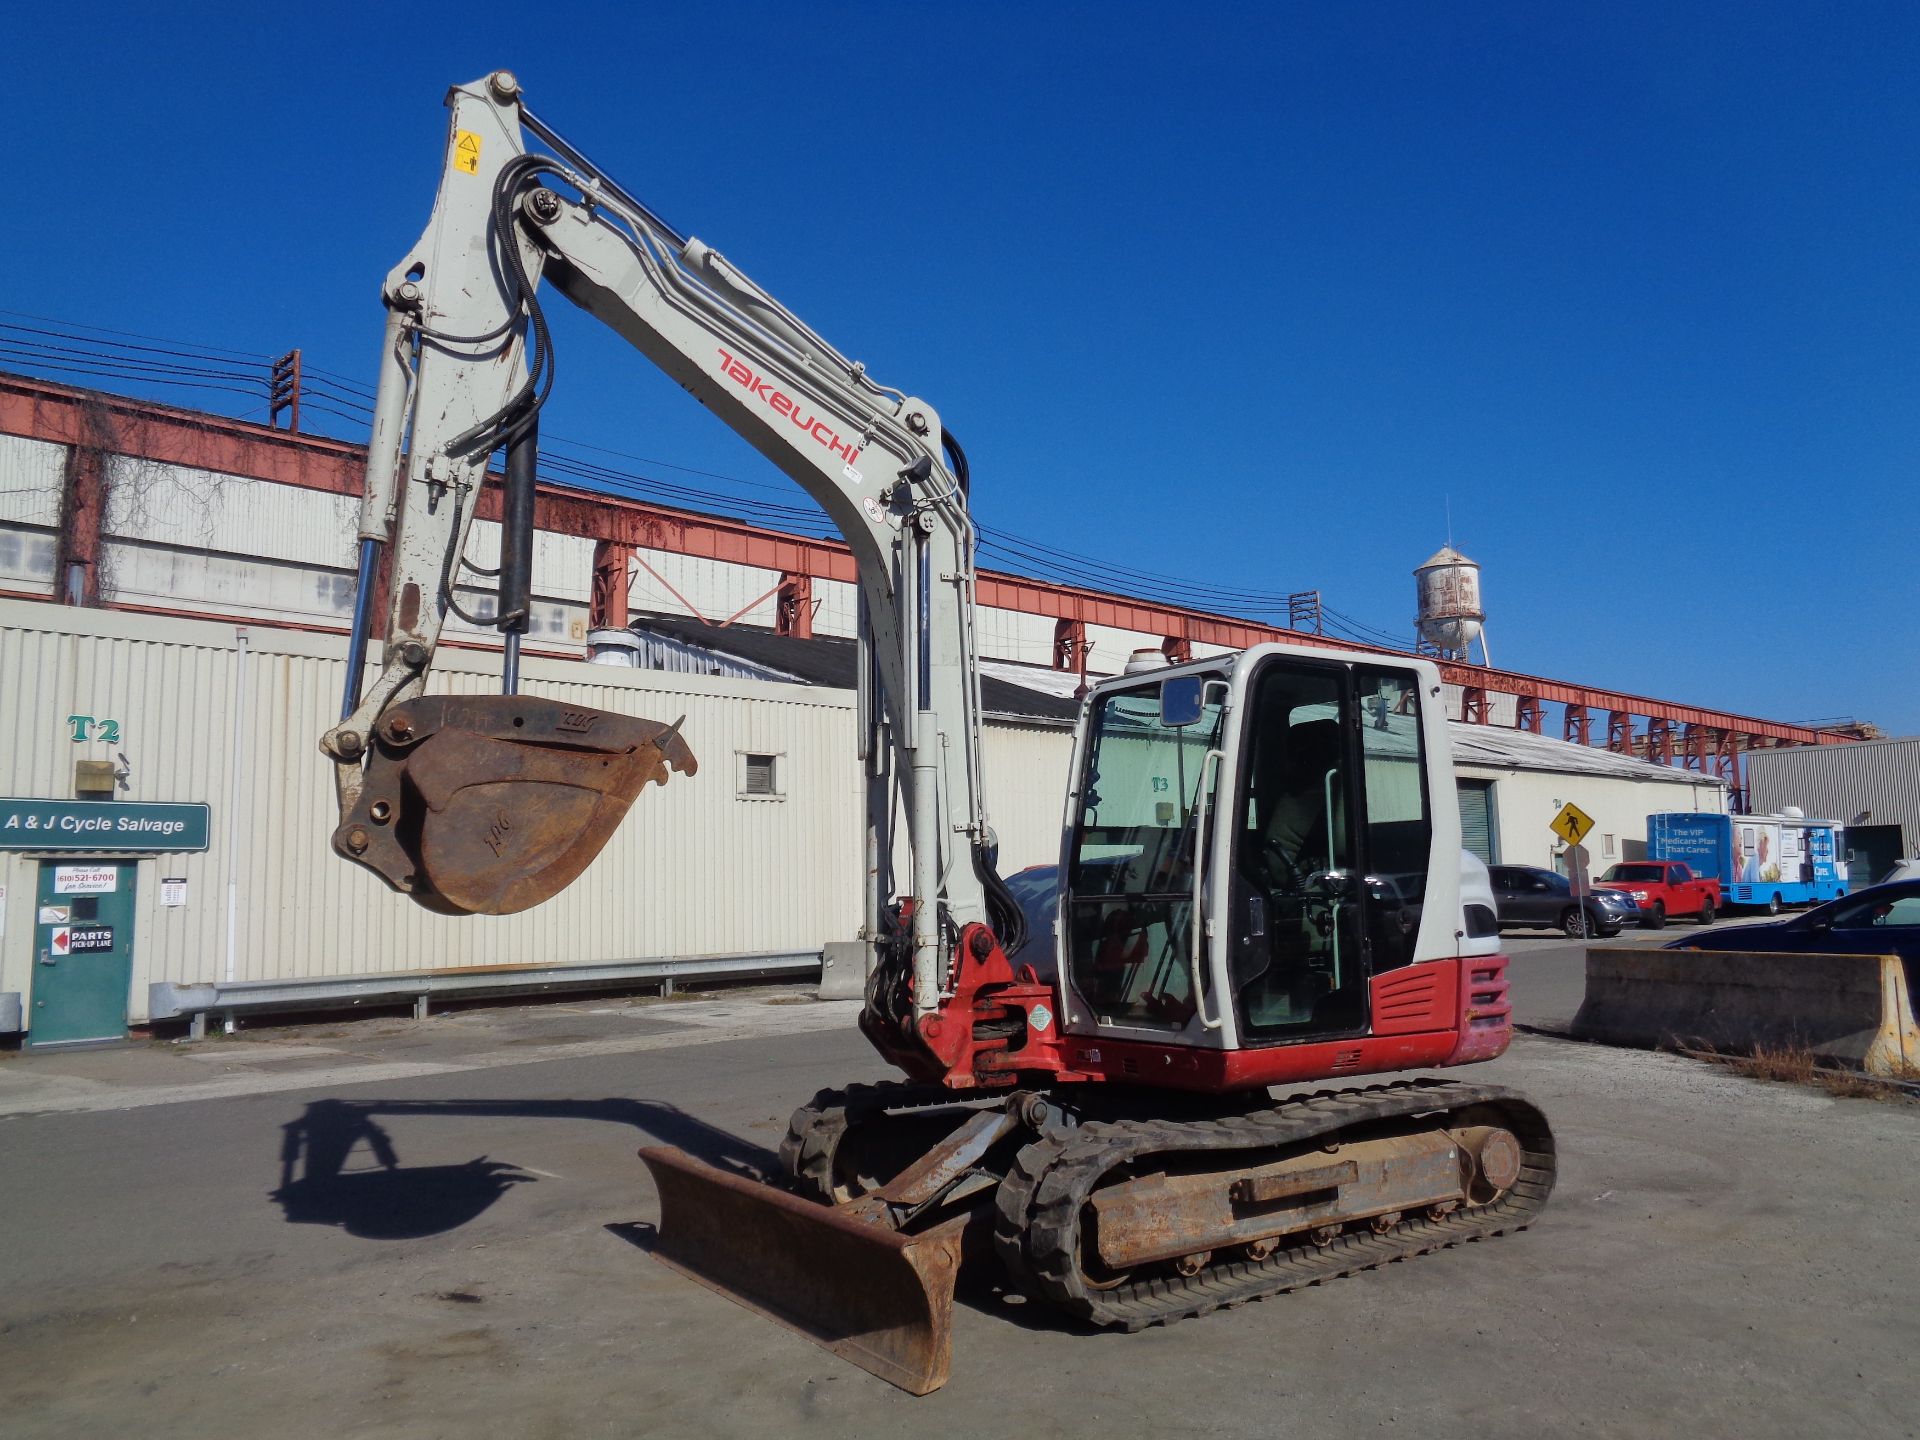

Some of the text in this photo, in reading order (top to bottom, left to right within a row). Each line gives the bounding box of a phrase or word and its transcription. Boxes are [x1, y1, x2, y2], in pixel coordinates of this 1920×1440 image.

[67, 714, 120, 744] T2
[1152, 776, 1168, 793] T3
[4, 814, 185, 835] A & J Cycle Salvage
[1660, 837, 1716, 845] Medicare Plan
[71, 931, 112, 940] PARTS
[71, 940, 95, 948] PICK-UP
